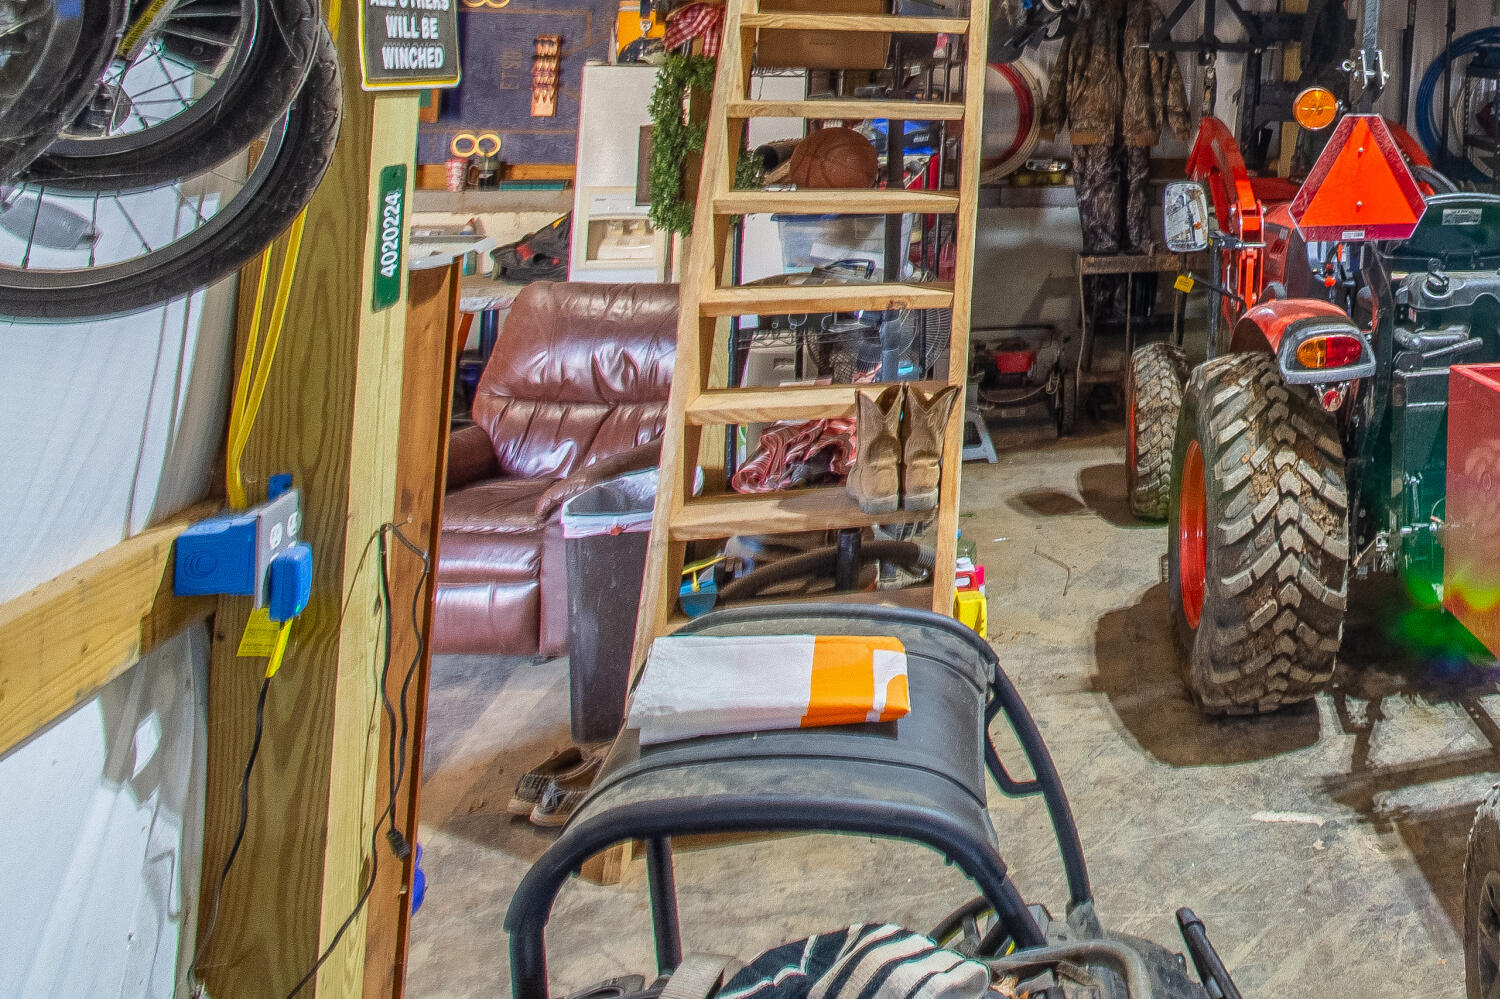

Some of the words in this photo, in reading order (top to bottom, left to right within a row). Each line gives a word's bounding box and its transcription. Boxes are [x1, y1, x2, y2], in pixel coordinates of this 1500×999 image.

[385, 14, 420, 40] WILL
[421, 17, 440, 41] BE
[382, 45, 444, 70] WINCHED
[380, 188, 402, 278] 4020224
